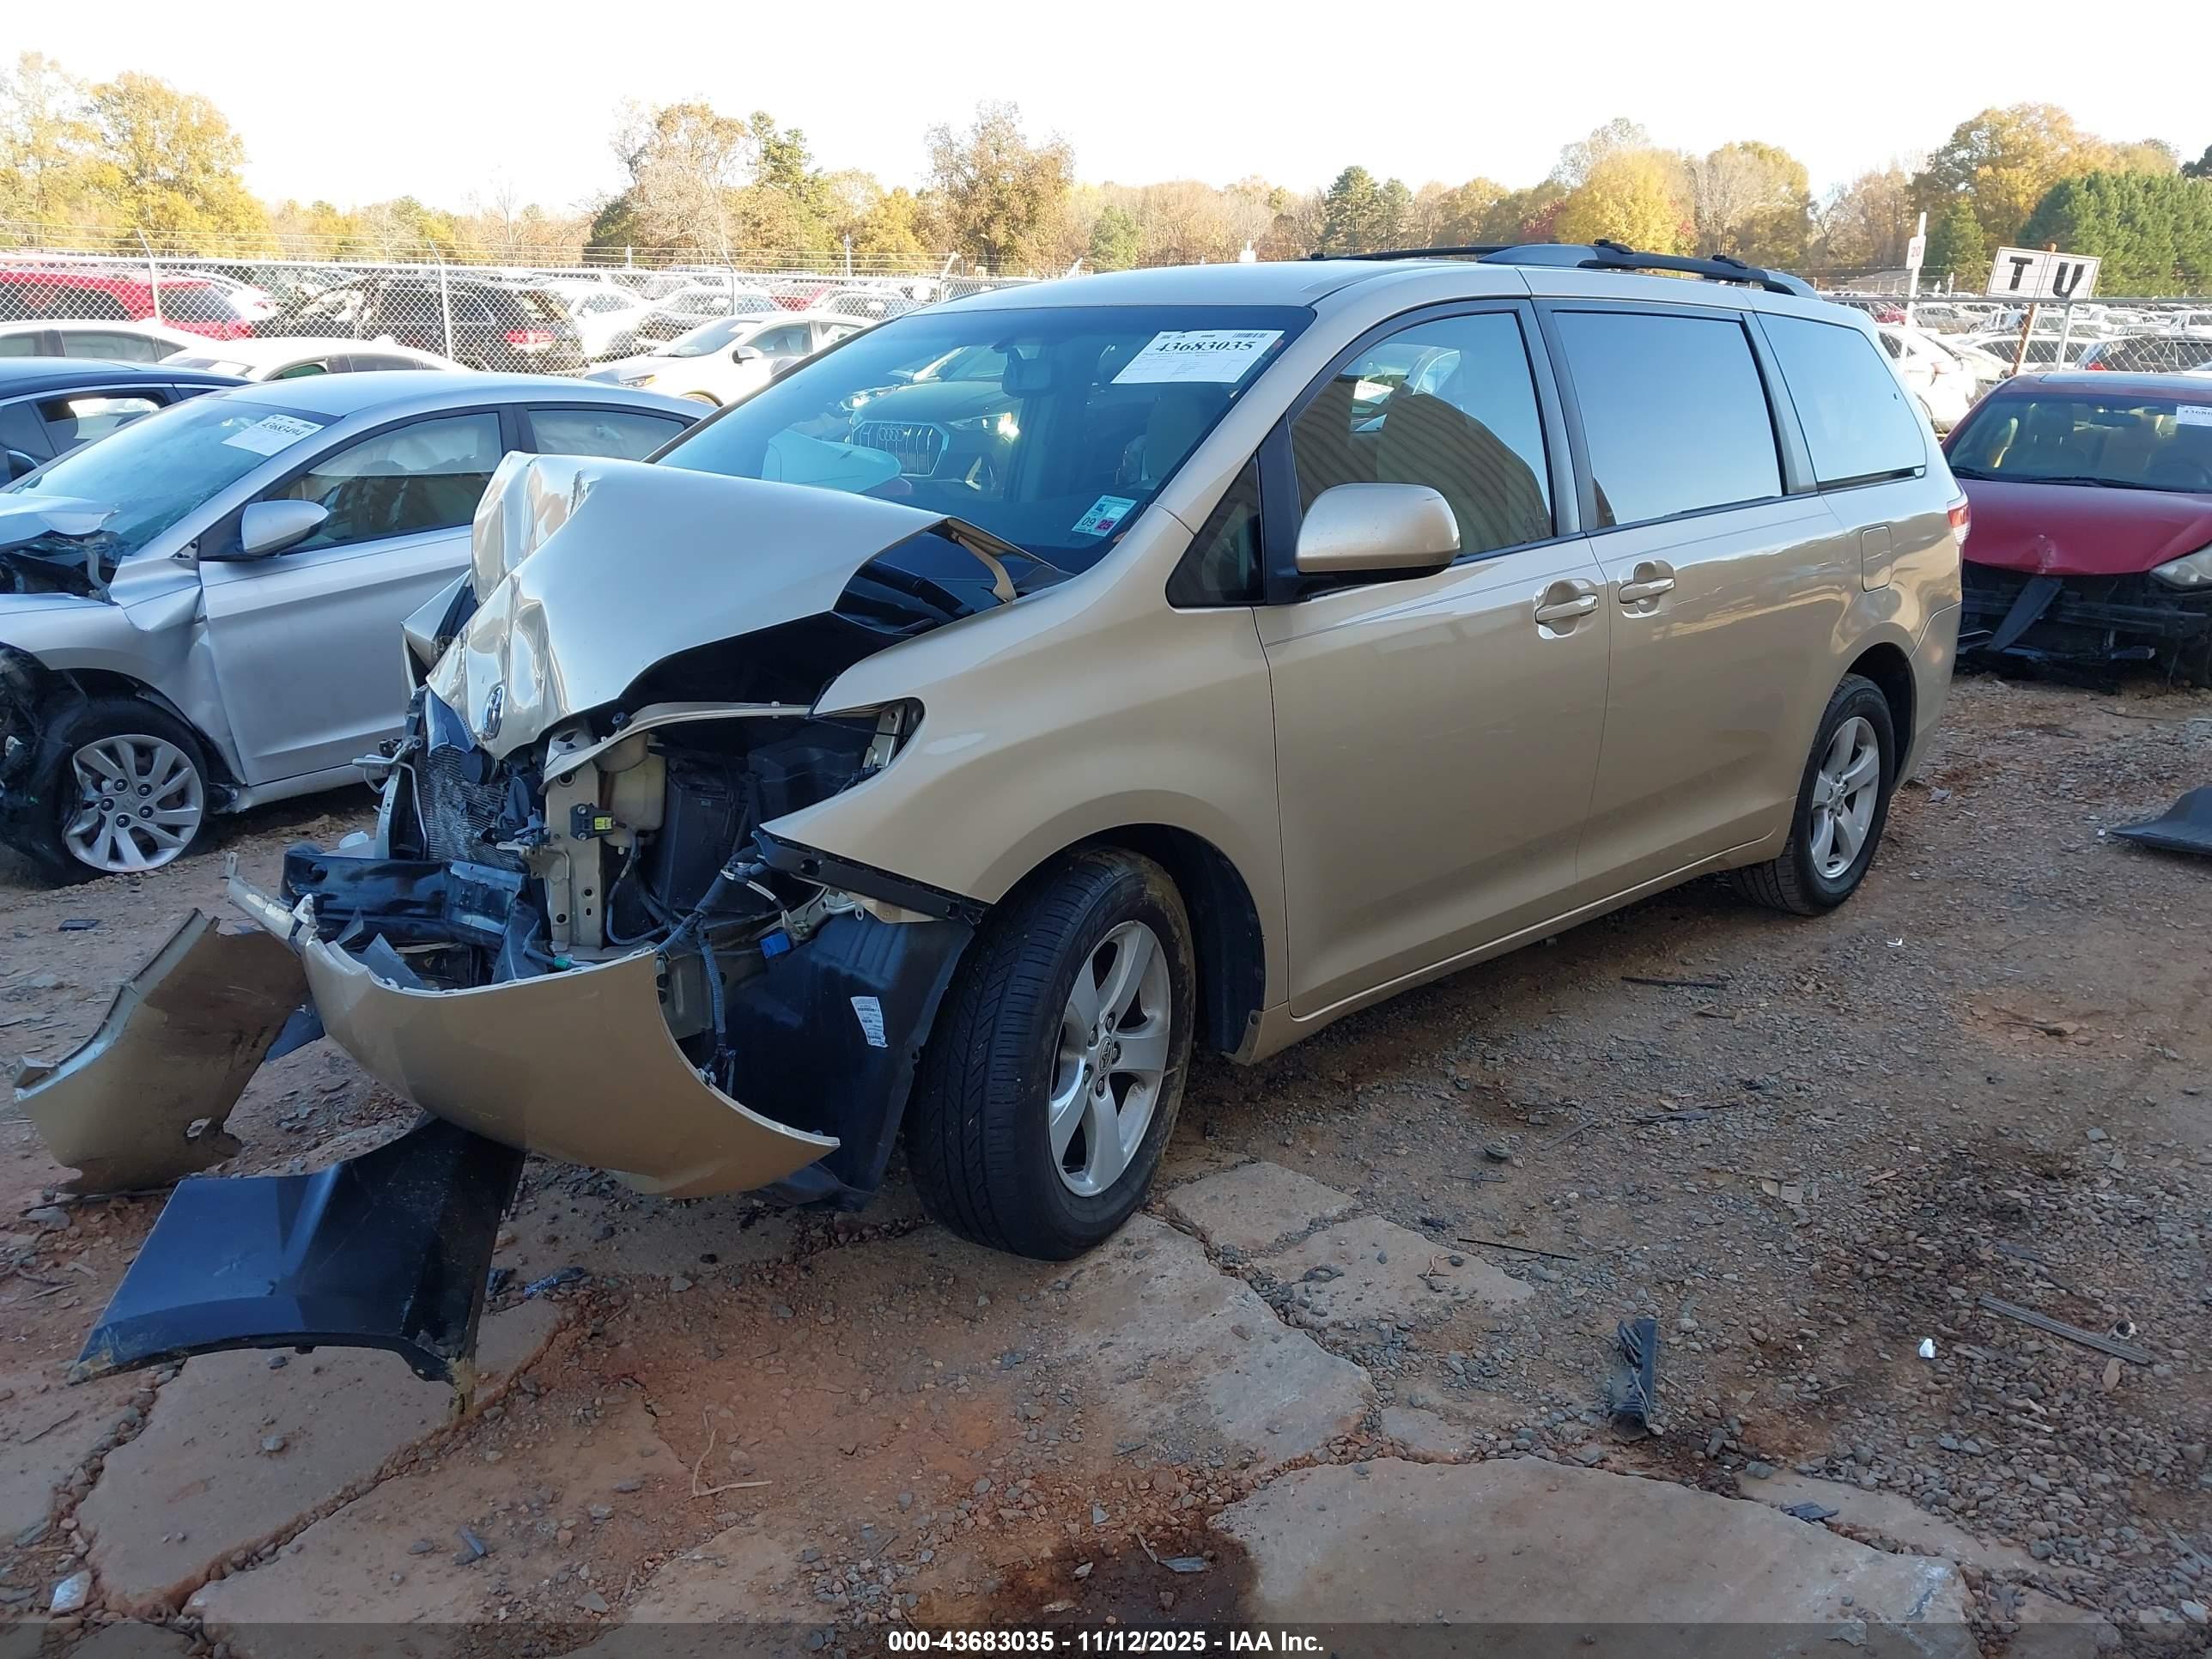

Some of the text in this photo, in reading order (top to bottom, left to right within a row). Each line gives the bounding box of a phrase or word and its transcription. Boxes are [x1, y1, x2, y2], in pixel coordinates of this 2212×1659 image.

[2009, 256, 2086, 298] T U
[1155, 340, 1257, 352] 43683035
[1081, 516, 1097, 527] 09
